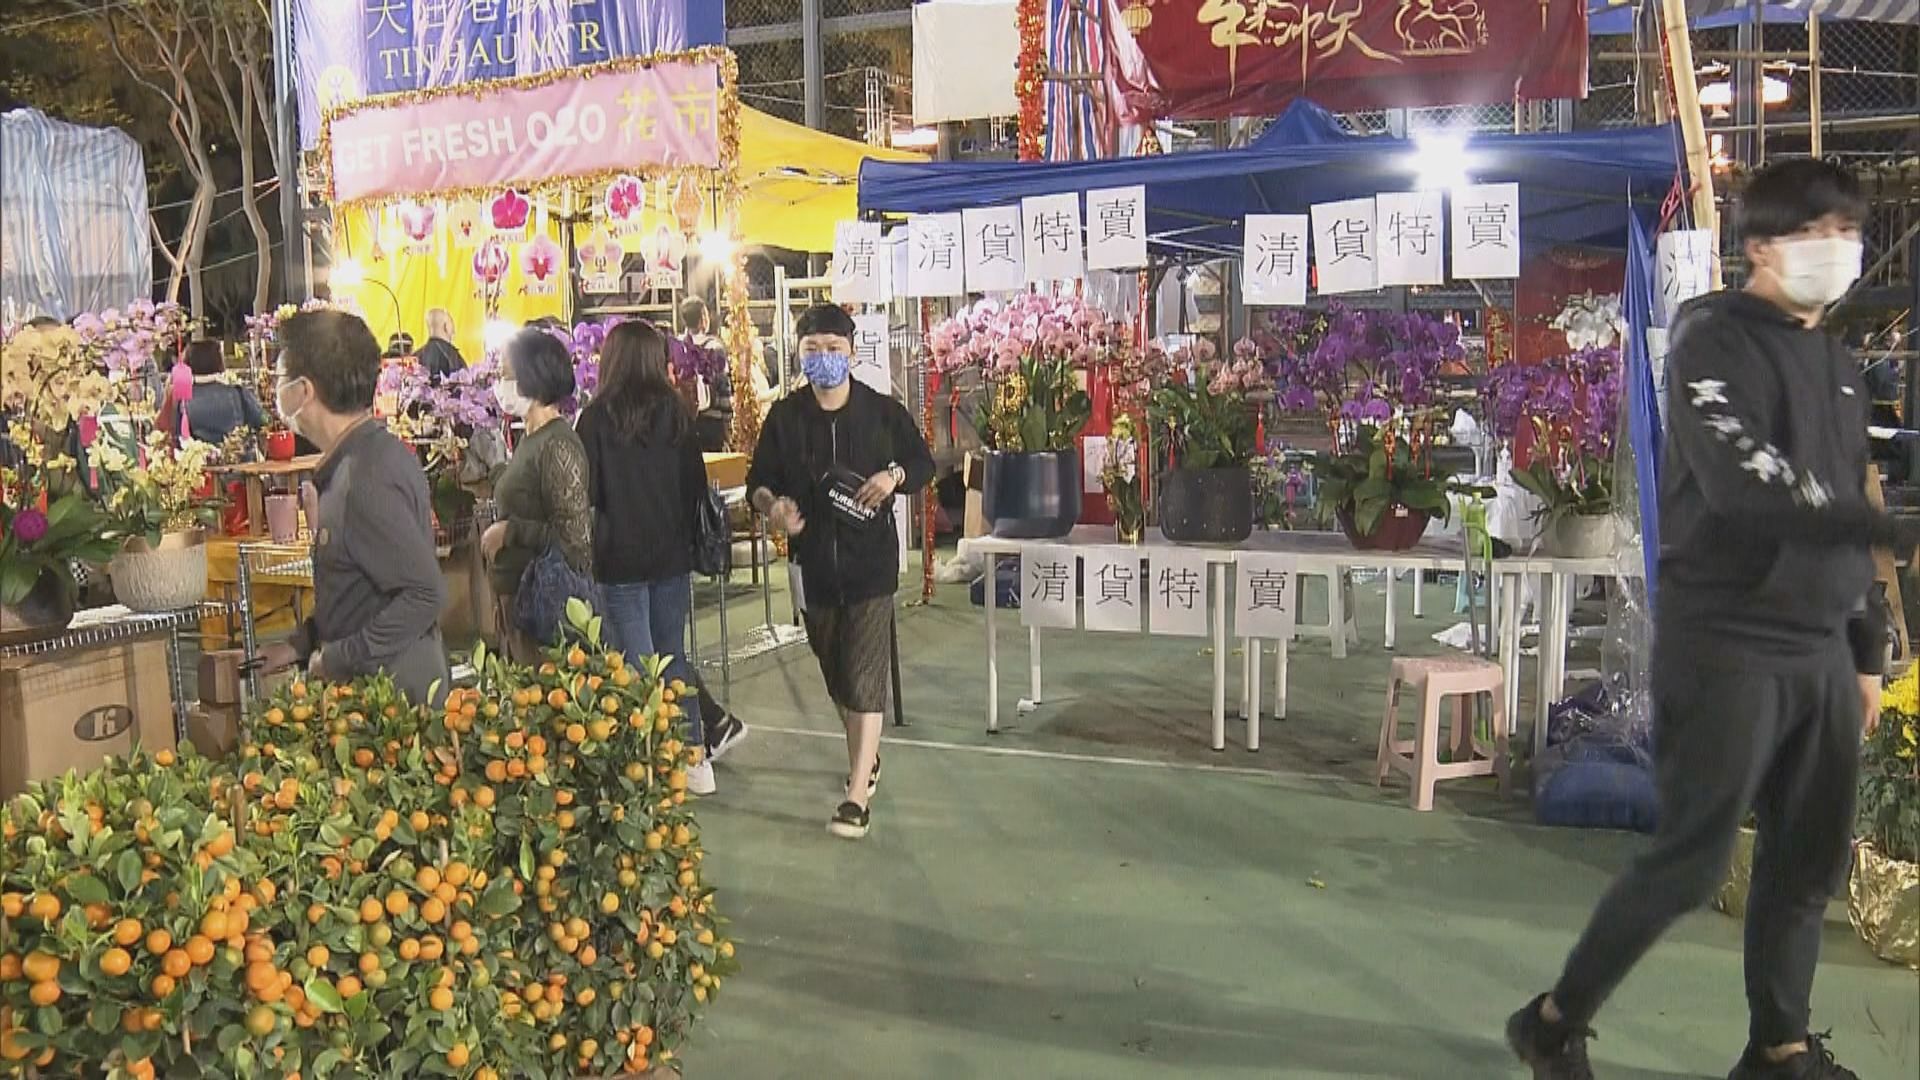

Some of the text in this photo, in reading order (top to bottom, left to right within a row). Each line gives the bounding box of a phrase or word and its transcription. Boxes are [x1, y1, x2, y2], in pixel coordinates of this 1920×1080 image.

[379, 20, 604, 80] TIN HAU MTR
[338, 134, 391, 174] GET
[402, 114, 518, 167] FRESH
[616, 85, 711, 144] 花市
[918, 199, 1137, 271] 清貨特賣
[1256, 202, 1511, 278] 清貨特賣
[1031, 561, 1289, 613] 清貨特賣
